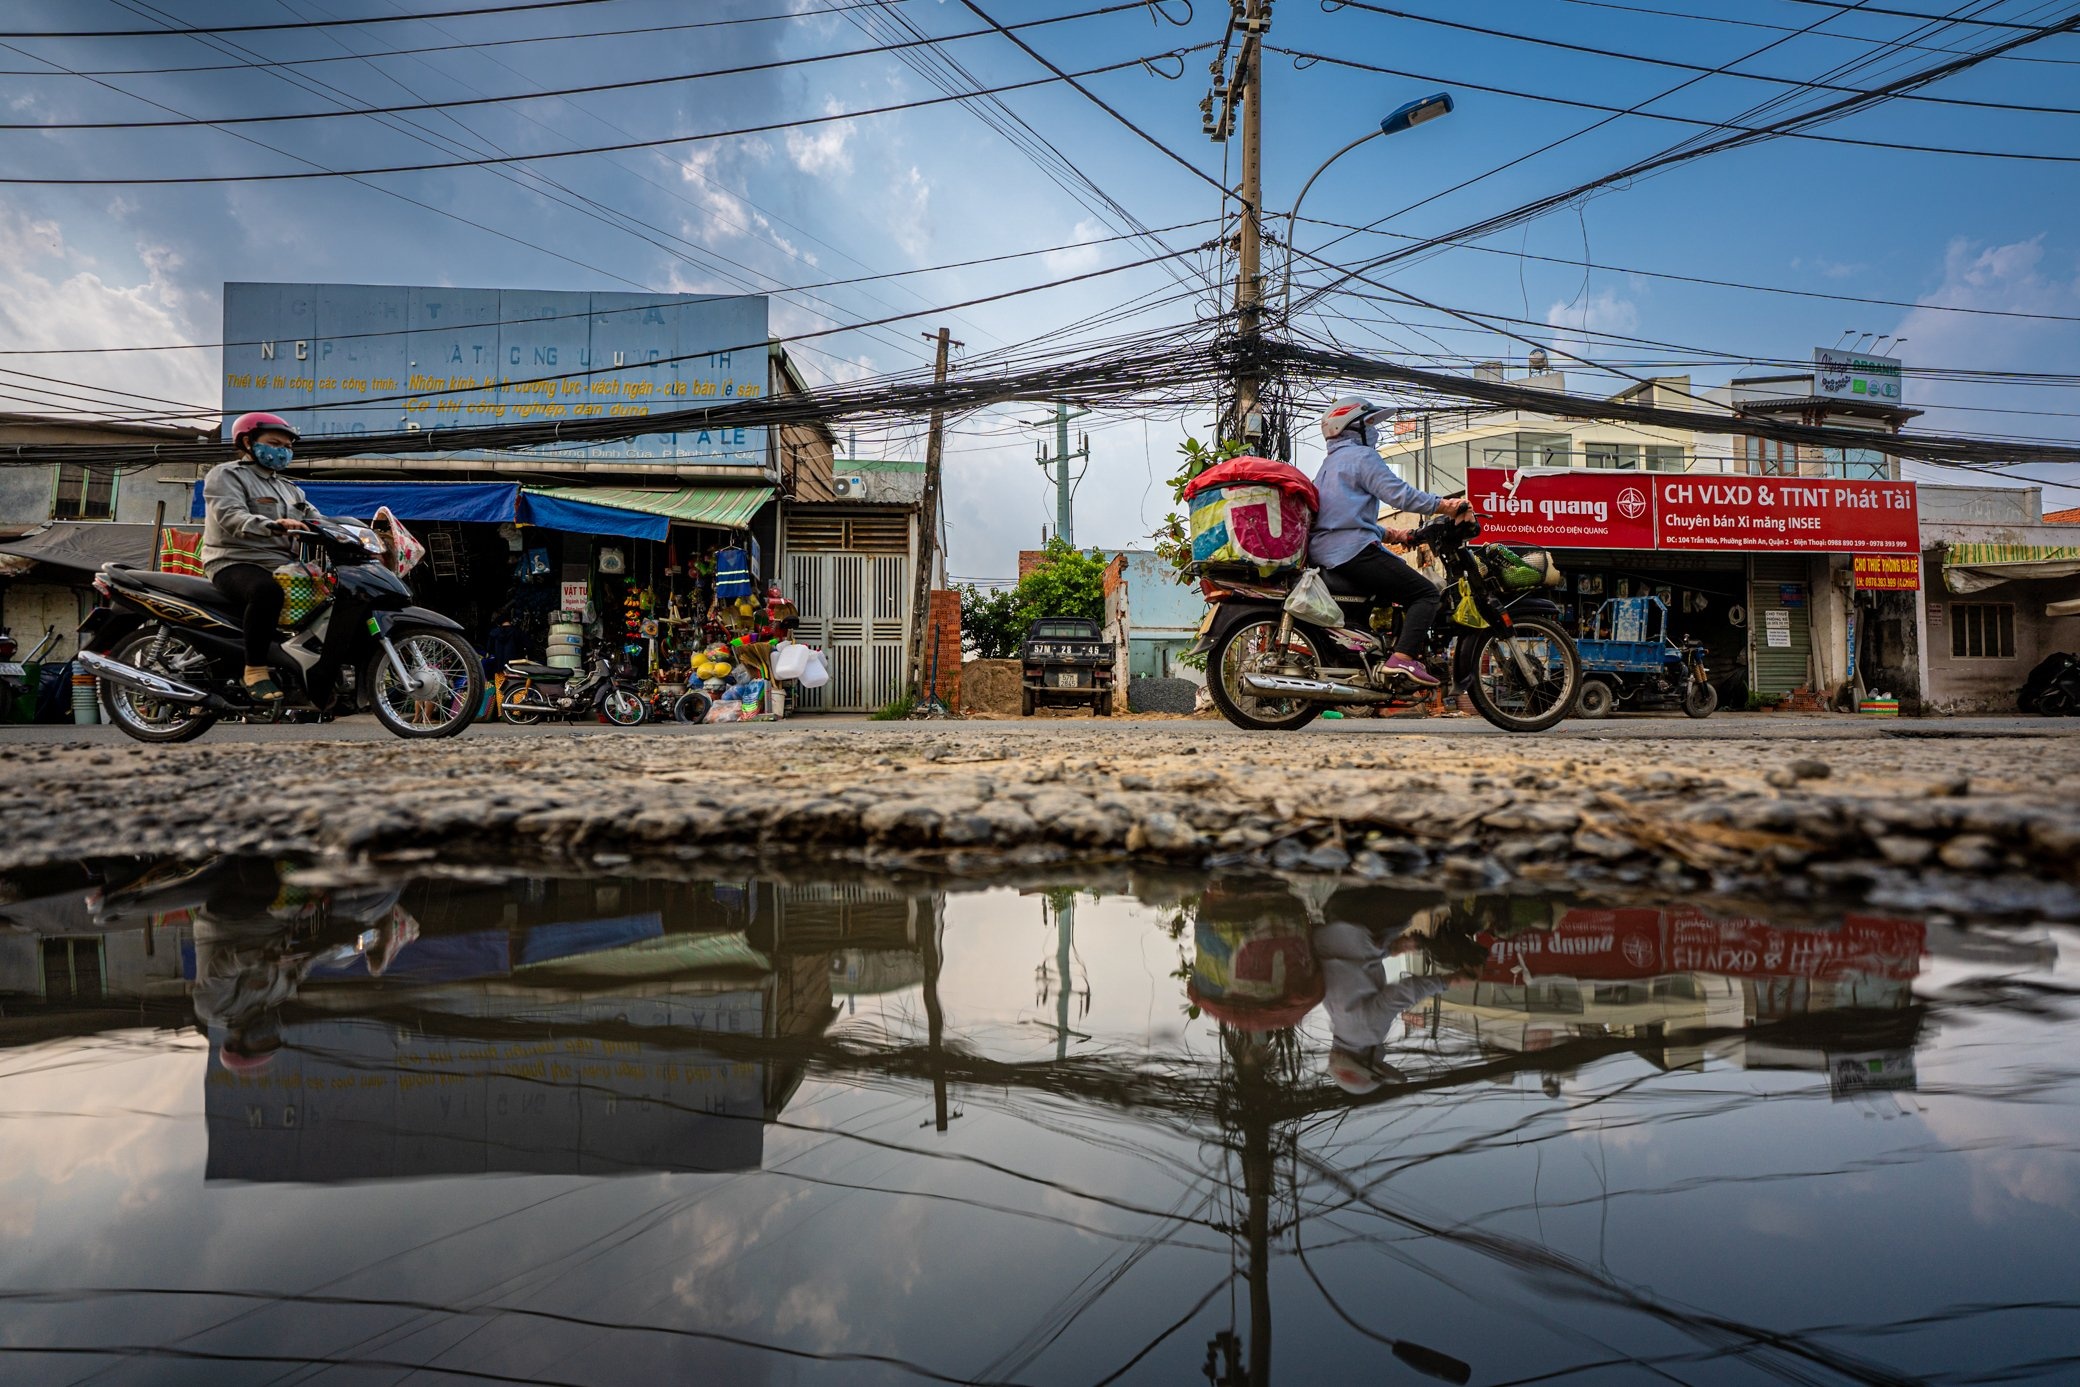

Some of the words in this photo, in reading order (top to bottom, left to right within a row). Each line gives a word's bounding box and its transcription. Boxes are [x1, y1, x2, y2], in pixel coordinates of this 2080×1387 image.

[318, 376, 338, 389] các
[408, 373, 445, 392] Nhôm
[1664, 484, 1693, 504] CH
[1698, 485, 1752, 505] VLXD
[1757, 485, 1775, 506] &
[1780, 487, 1829, 507] TTNT
[1835, 488, 1878, 509] Phát
[1882, 489, 1911, 509] Tài
[1539, 501, 1608, 522] quang
[1507, 525, 1518, 533] CÓ
[1555, 525, 1566, 534] CÓ
[1583, 527, 1609, 535] QUANG
[1665, 514, 1710, 530] Chuyên
[1713, 515, 1735, 527] bán
[1738, 515, 1750, 528] Xi
[1753, 516, 1786, 532] măng
[1788, 517, 1821, 529] INSEE
[1855, 557, 1866, 572] CHO
[564, 584, 577, 597] VẬT
[1061, 645, 1072, 654] 28
[1088, 646, 1100, 655] 45
